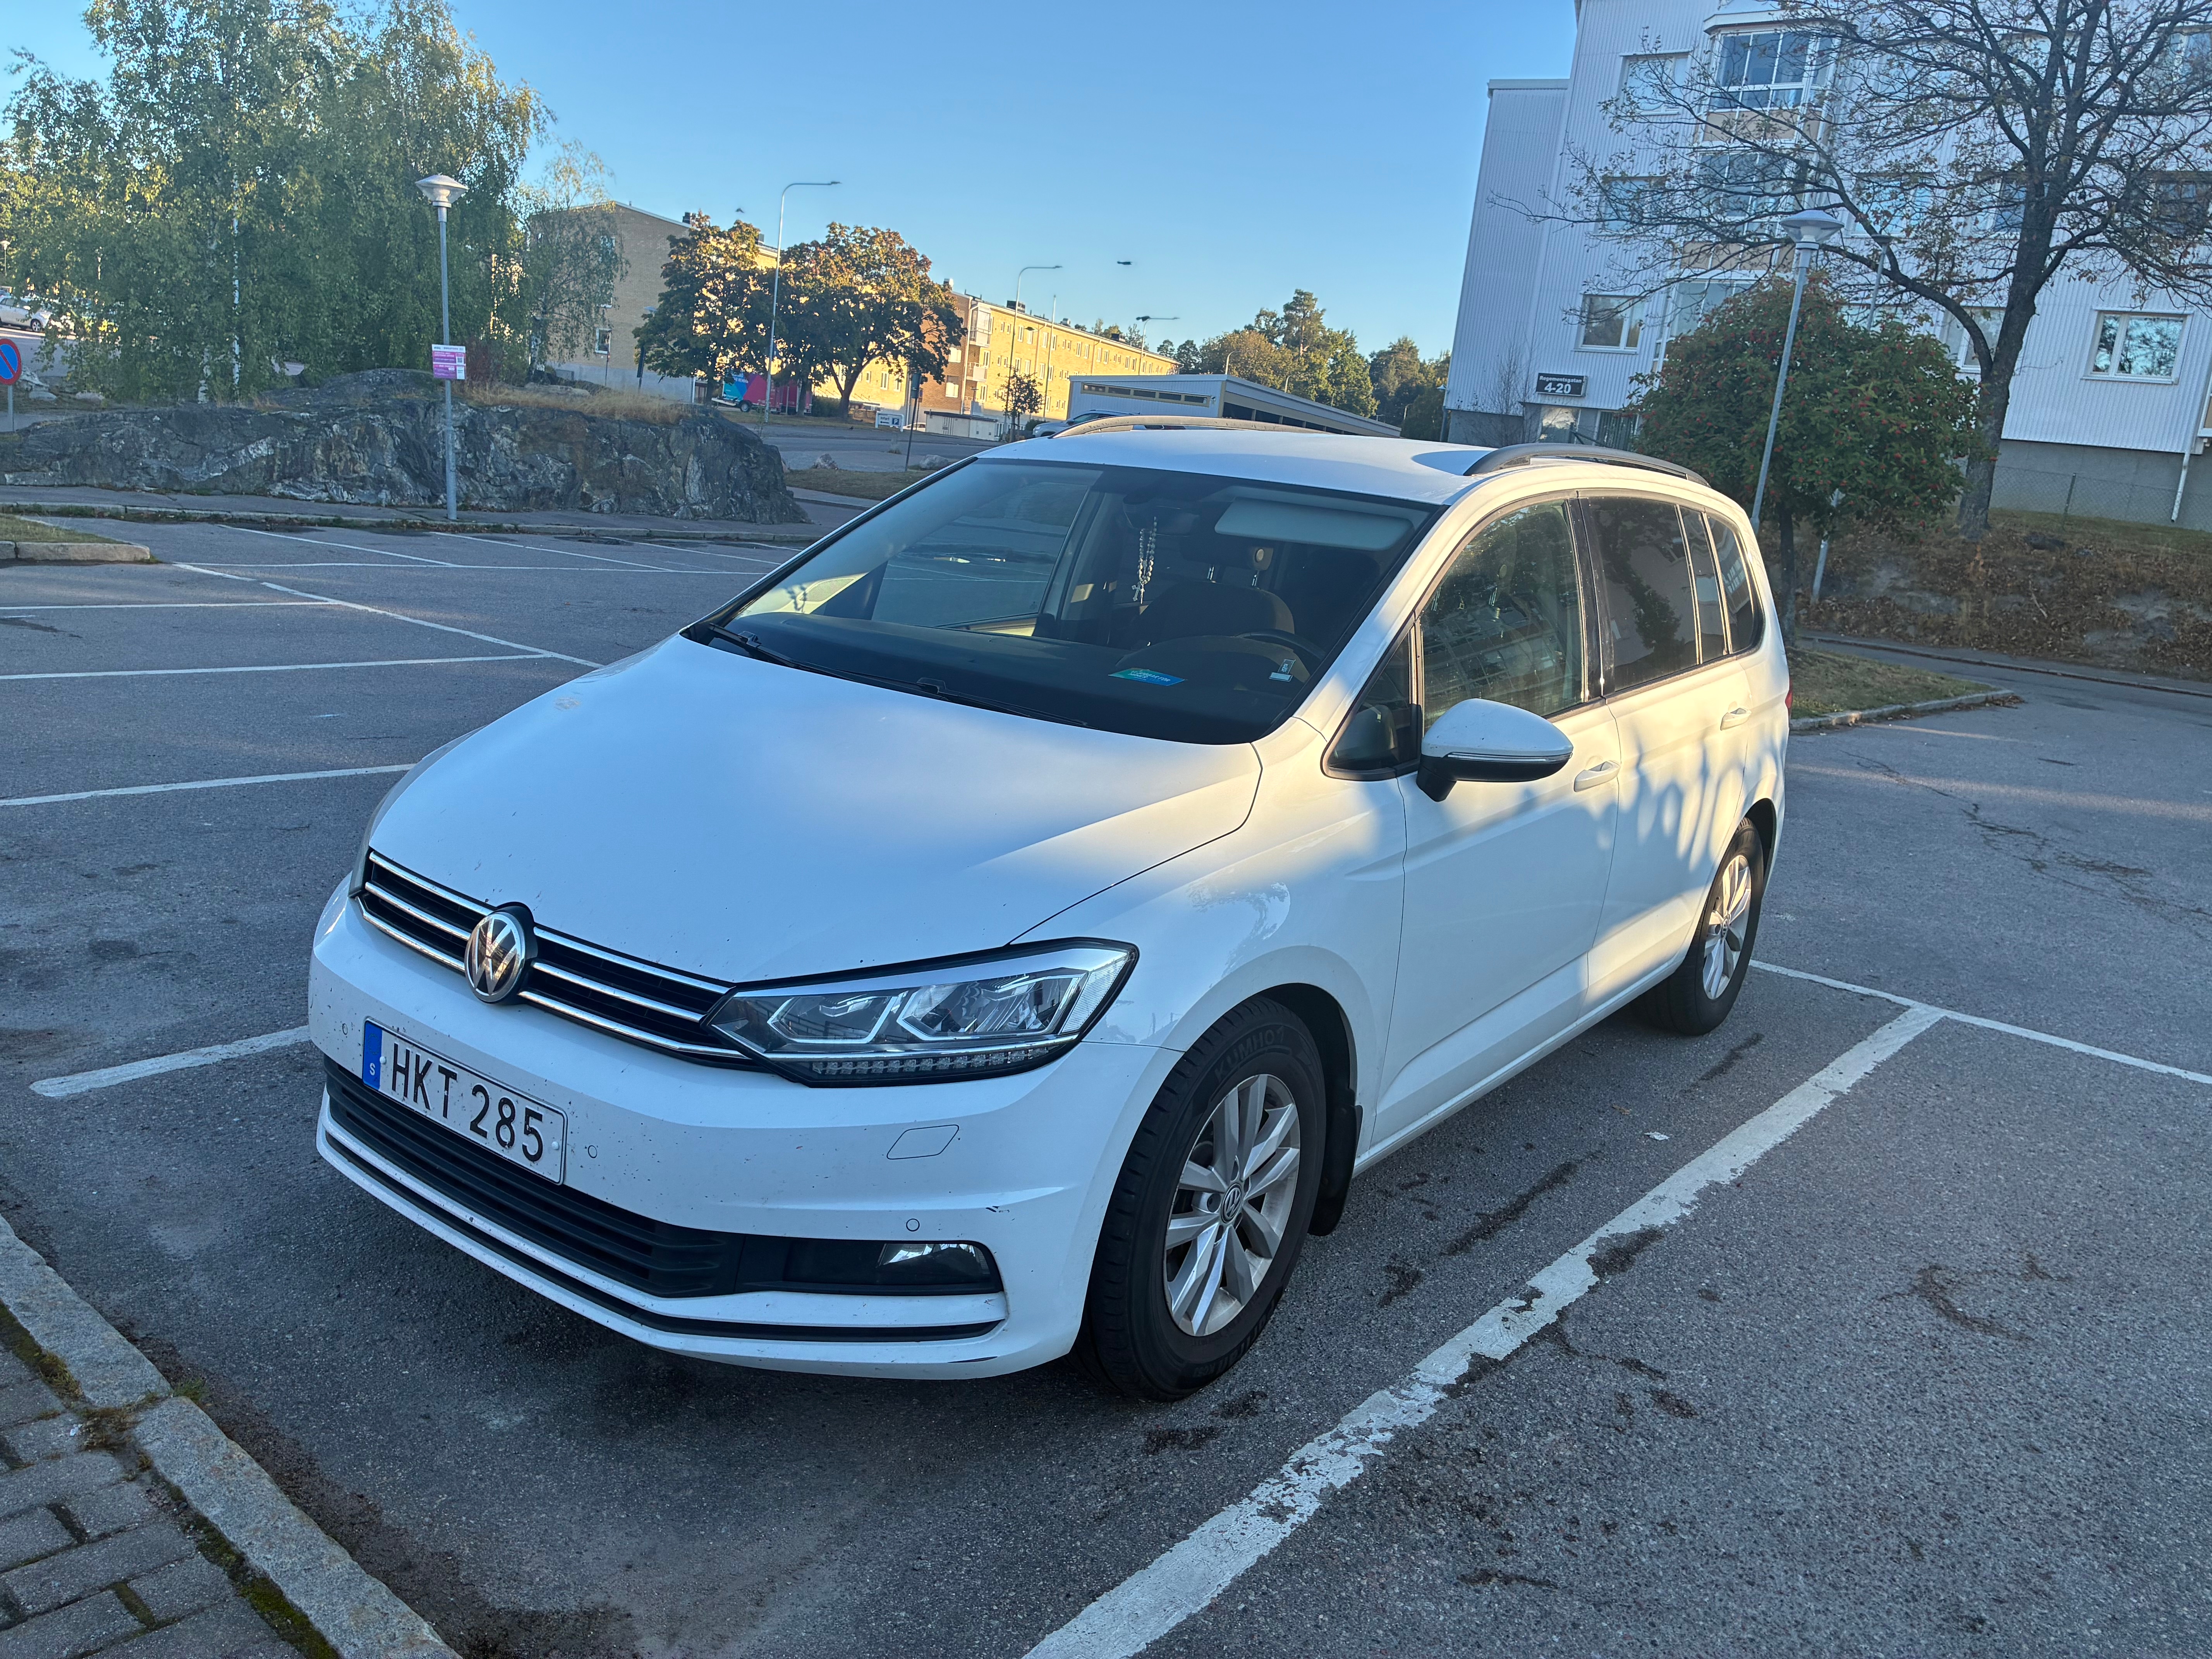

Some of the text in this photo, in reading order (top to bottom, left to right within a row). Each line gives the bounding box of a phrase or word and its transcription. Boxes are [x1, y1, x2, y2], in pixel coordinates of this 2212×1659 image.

[1544, 382, 1571, 394] 4-20
[369, 1063, 376, 1077] S
[1214, 1029, 1275, 1081] KUMHO
[392, 1042, 543, 1162] HKT 285
